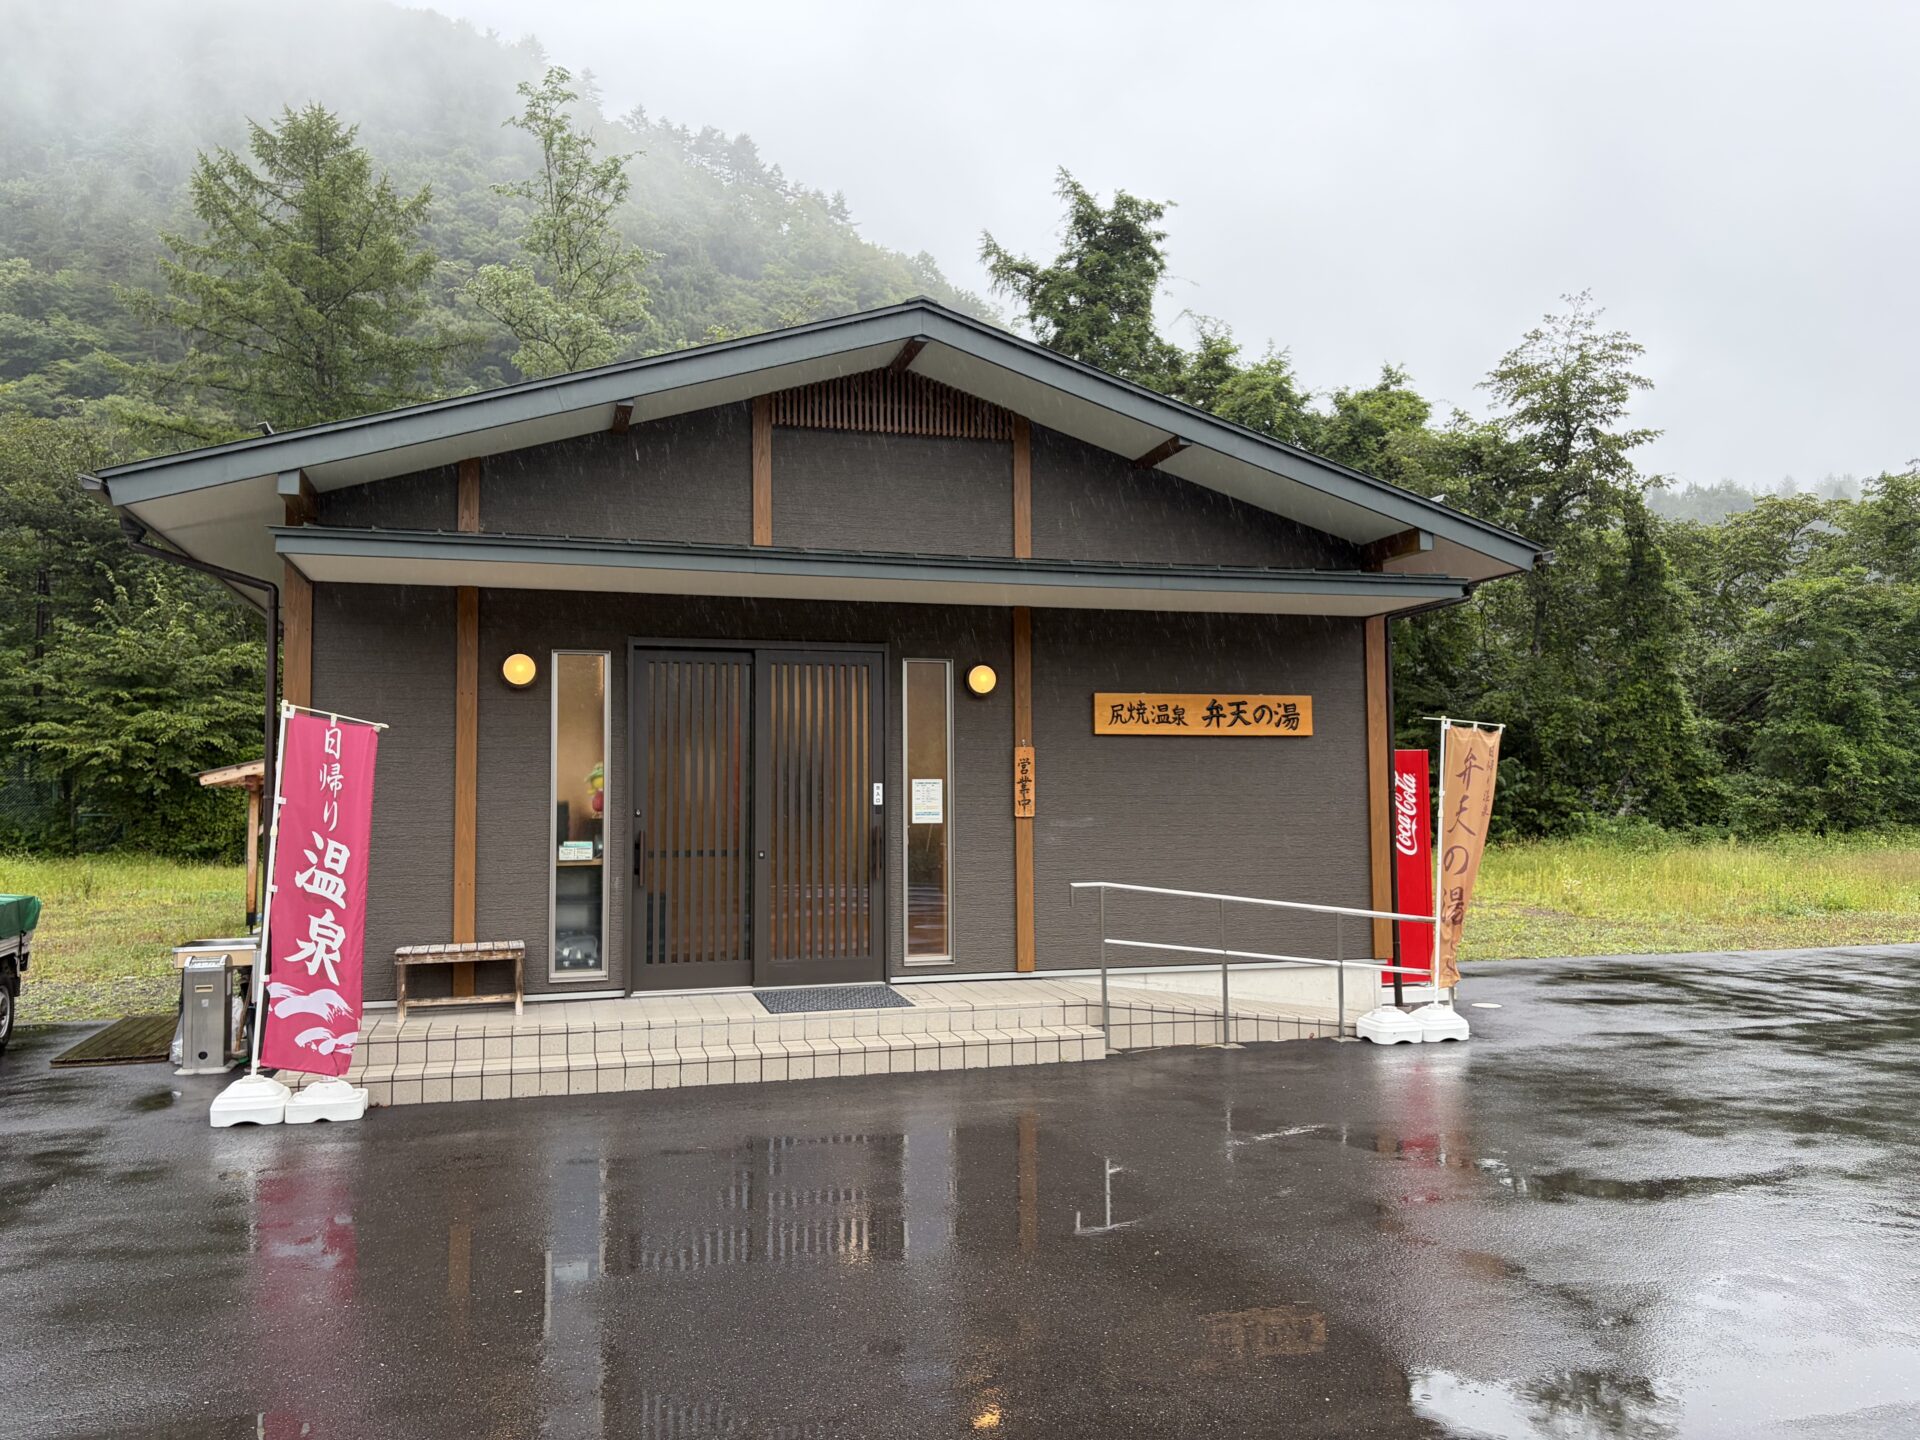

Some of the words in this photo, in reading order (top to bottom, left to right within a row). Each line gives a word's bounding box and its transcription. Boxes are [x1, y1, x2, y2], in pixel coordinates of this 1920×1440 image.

[1108, 699, 1190, 727] 尻焼温泉
[1201, 698, 1301, 731] 弁天の湯
[1016, 757, 1032, 813] 営業中
